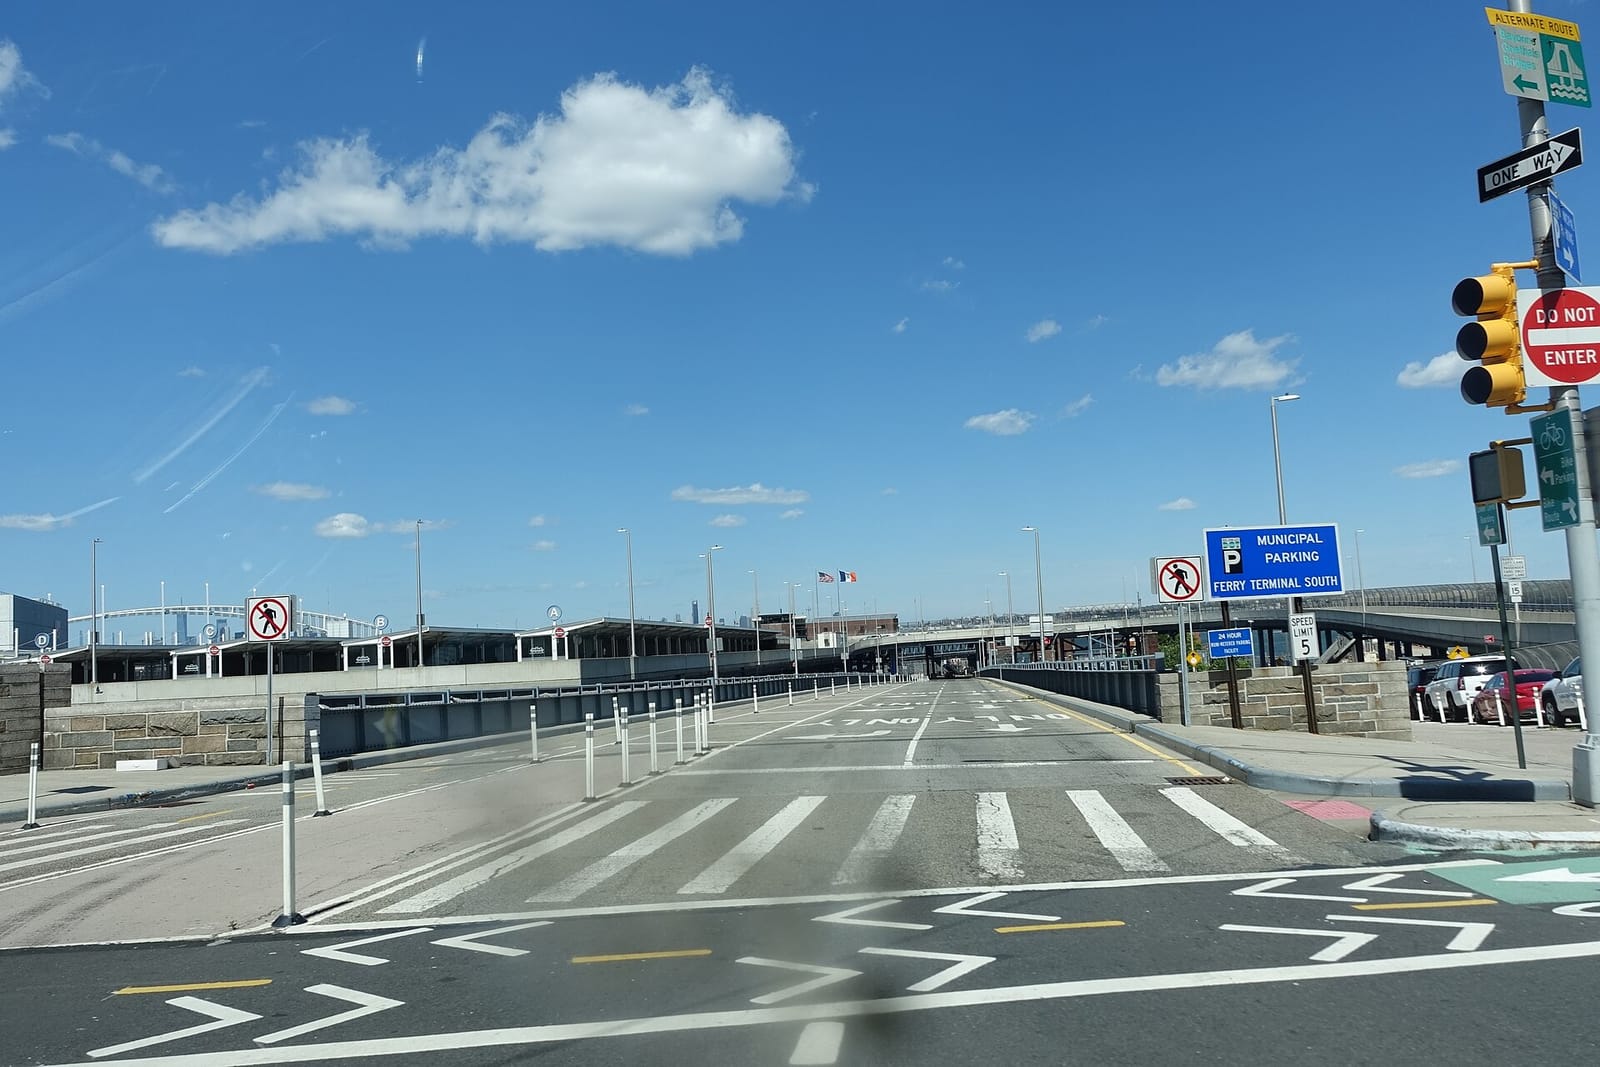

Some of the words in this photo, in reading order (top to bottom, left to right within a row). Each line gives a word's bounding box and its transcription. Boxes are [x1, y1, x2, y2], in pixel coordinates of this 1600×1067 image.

[1495, 13, 1545, 30] ALTERNATE
[1548, 21, 1575, 36] ROUTE
[1492, 164, 1520, 187] ONE
[1533, 147, 1564, 170] WAY
[1536, 308, 1558, 324] DO
[1564, 306, 1596, 323] NOT
[1544, 348, 1598, 366] ENTER
[1257, 533, 1324, 546] MUNICIPAL
[1223, 550, 1241, 573] P
[1265, 551, 1320, 564] PARKING
[1213, 580, 1246, 593] FERRY
[1250, 577, 1302, 590] TERMINAL
[1304, 575, 1338, 588] SOUTH
[1511, 587, 1520, 595] 15
[550, 607, 558, 617] A
[377, 617, 385, 627] B
[1291, 617, 1314, 626] SPEED
[206, 626, 214, 636] C
[1294, 628, 1313, 637] LIMIT
[38, 635, 47, 645] D
[1301, 639, 1310, 655] 5
[796, 718, 920, 727] ONLY
[934, 713, 1071, 724] ONLY
